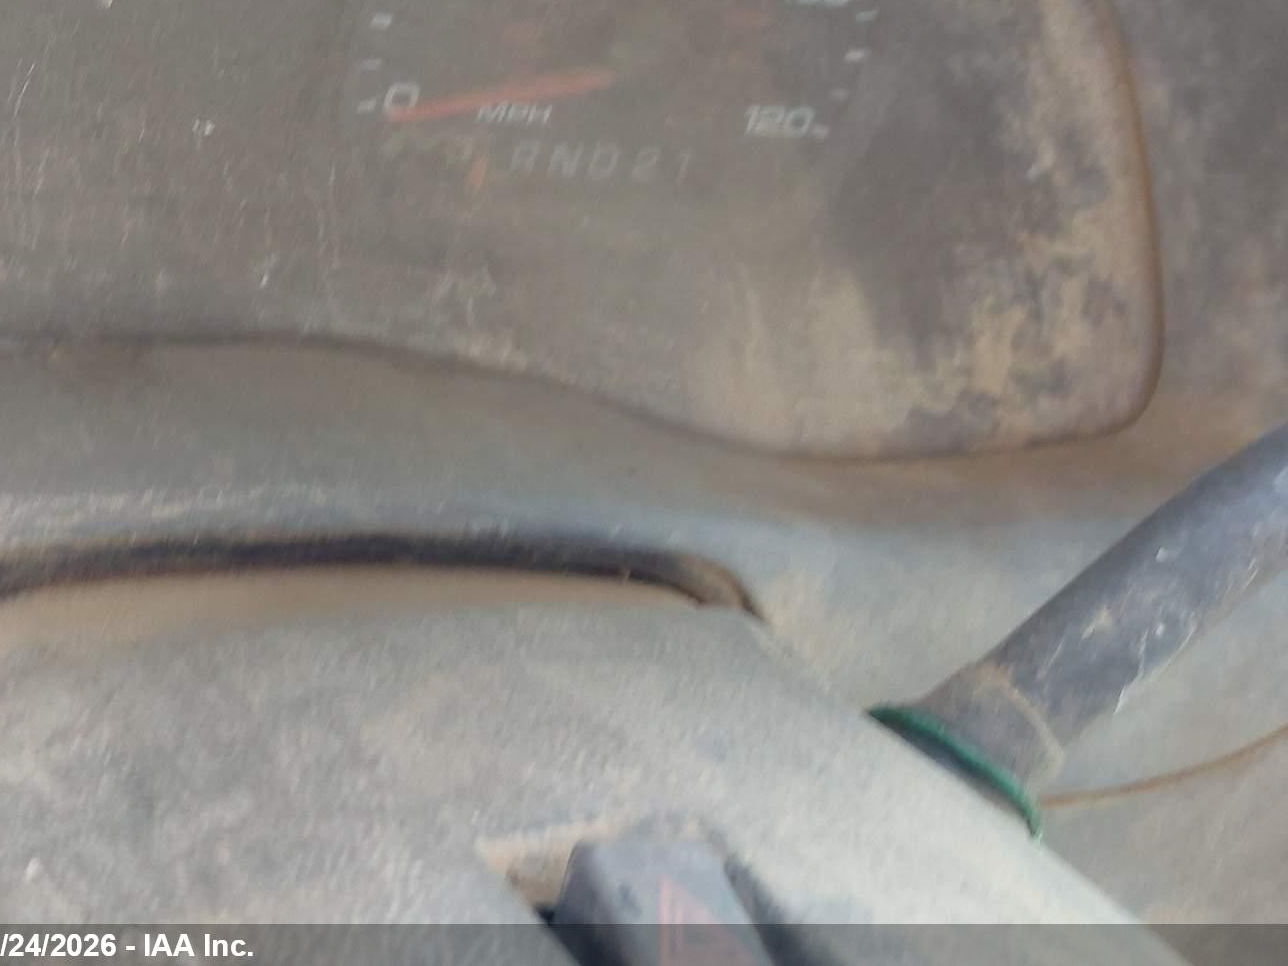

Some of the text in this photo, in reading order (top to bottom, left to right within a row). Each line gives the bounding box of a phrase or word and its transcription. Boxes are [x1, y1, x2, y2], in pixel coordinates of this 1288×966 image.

[384, 82, 420, 114] 0
[476, 103, 553, 126] MPH
[743, 105, 812, 138] 120
